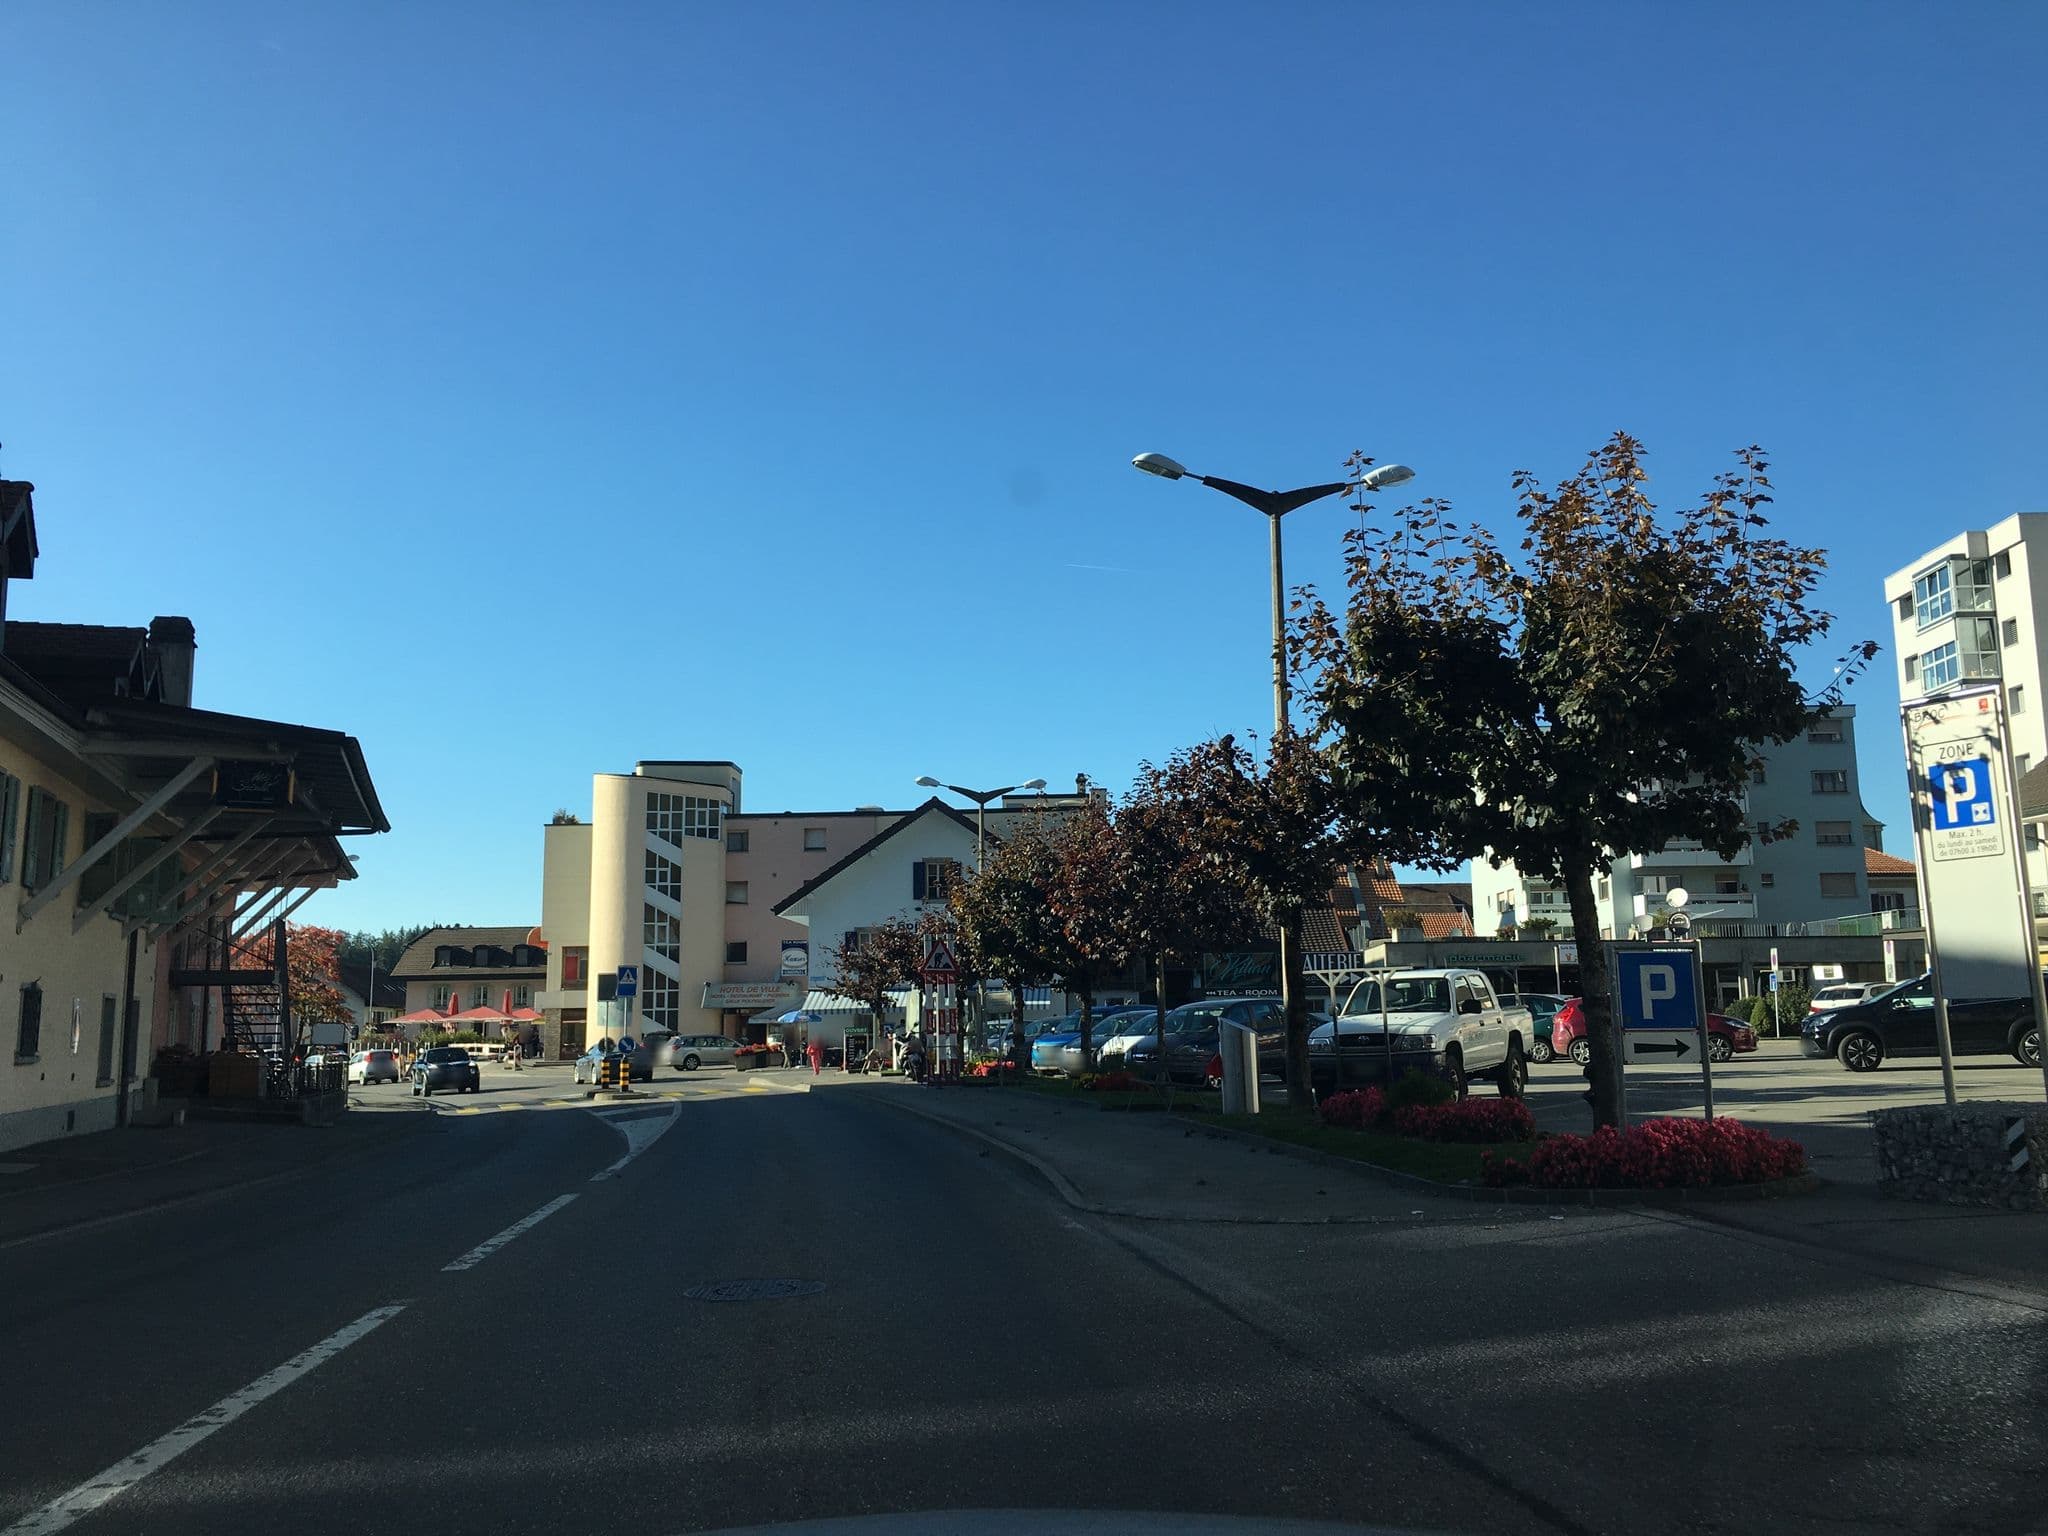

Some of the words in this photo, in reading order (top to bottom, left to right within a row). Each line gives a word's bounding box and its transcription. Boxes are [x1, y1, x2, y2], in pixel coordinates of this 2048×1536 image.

[1939, 742, 1974, 760] ZONE
[1942, 767, 1977, 823] P
[1969, 829, 1975, 837] 2
[1302, 953, 1361, 971] AITERIE
[747, 986, 758, 994] DE
[1640, 965, 1676, 1019] P
